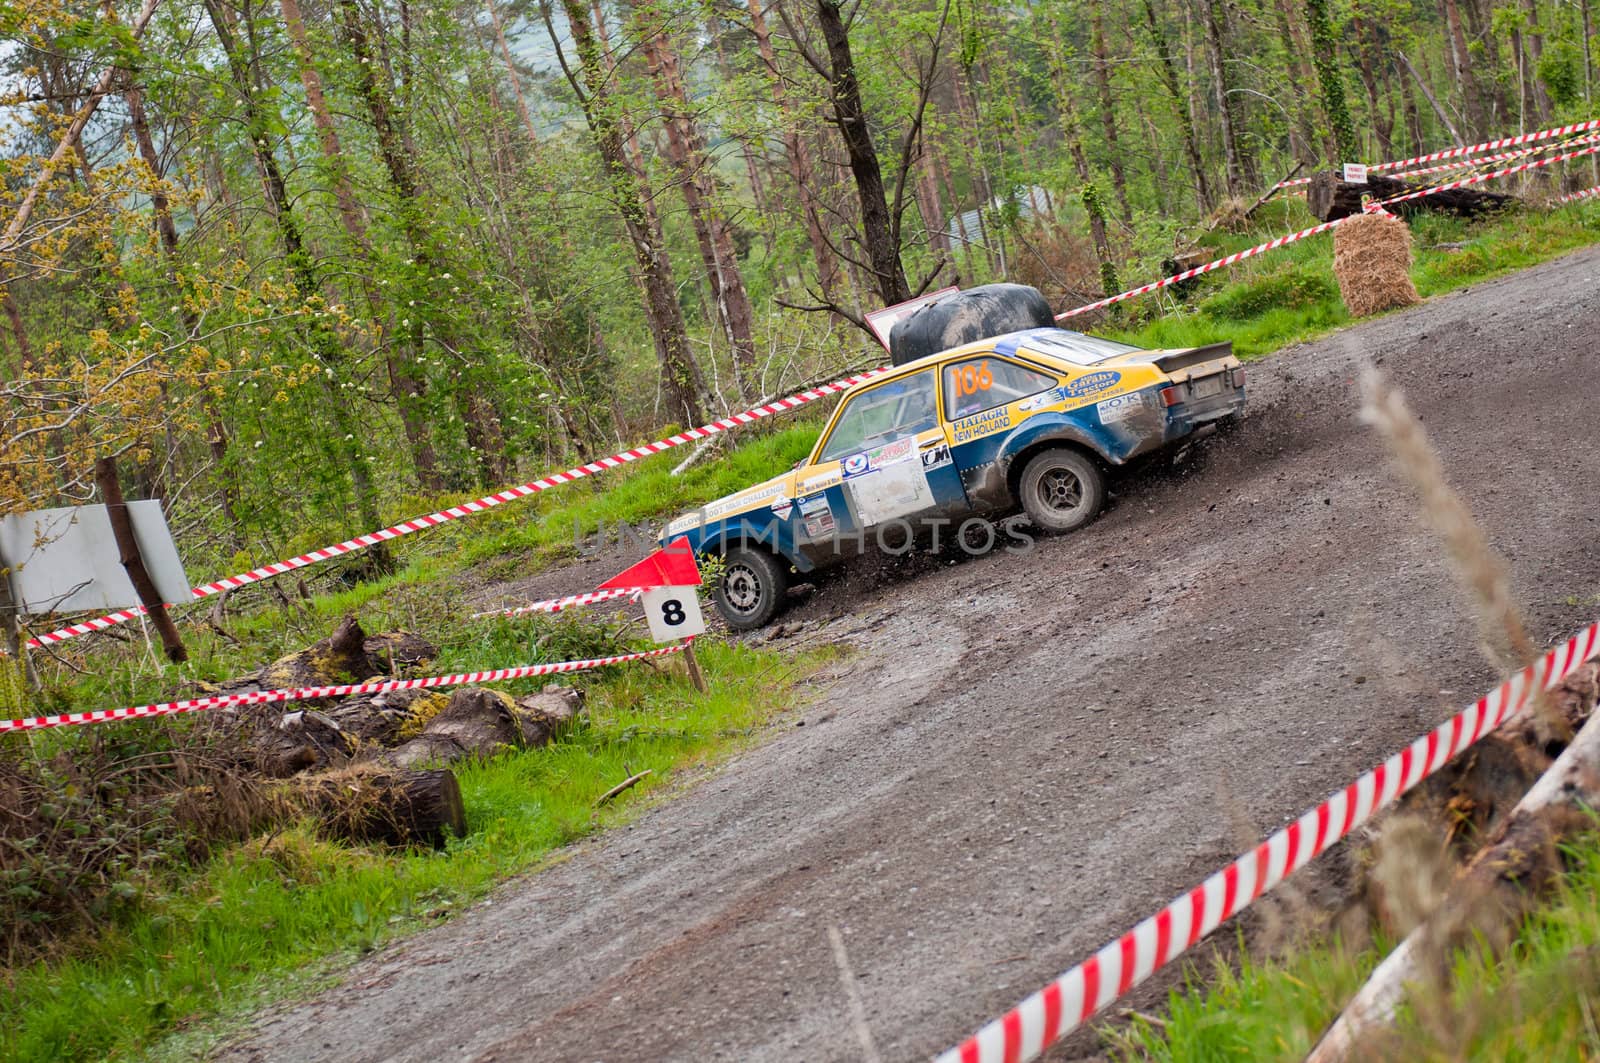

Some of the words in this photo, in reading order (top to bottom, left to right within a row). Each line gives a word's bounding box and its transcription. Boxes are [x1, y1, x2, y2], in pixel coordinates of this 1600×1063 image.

[952, 360, 993, 398] 106
[1068, 379, 1116, 396] Tractors
[953, 406, 1009, 431] FIATAGRI
[954, 429, 972, 442] NEW
[973, 416, 1011, 436] HOLLAND
[661, 599, 686, 626] 8
